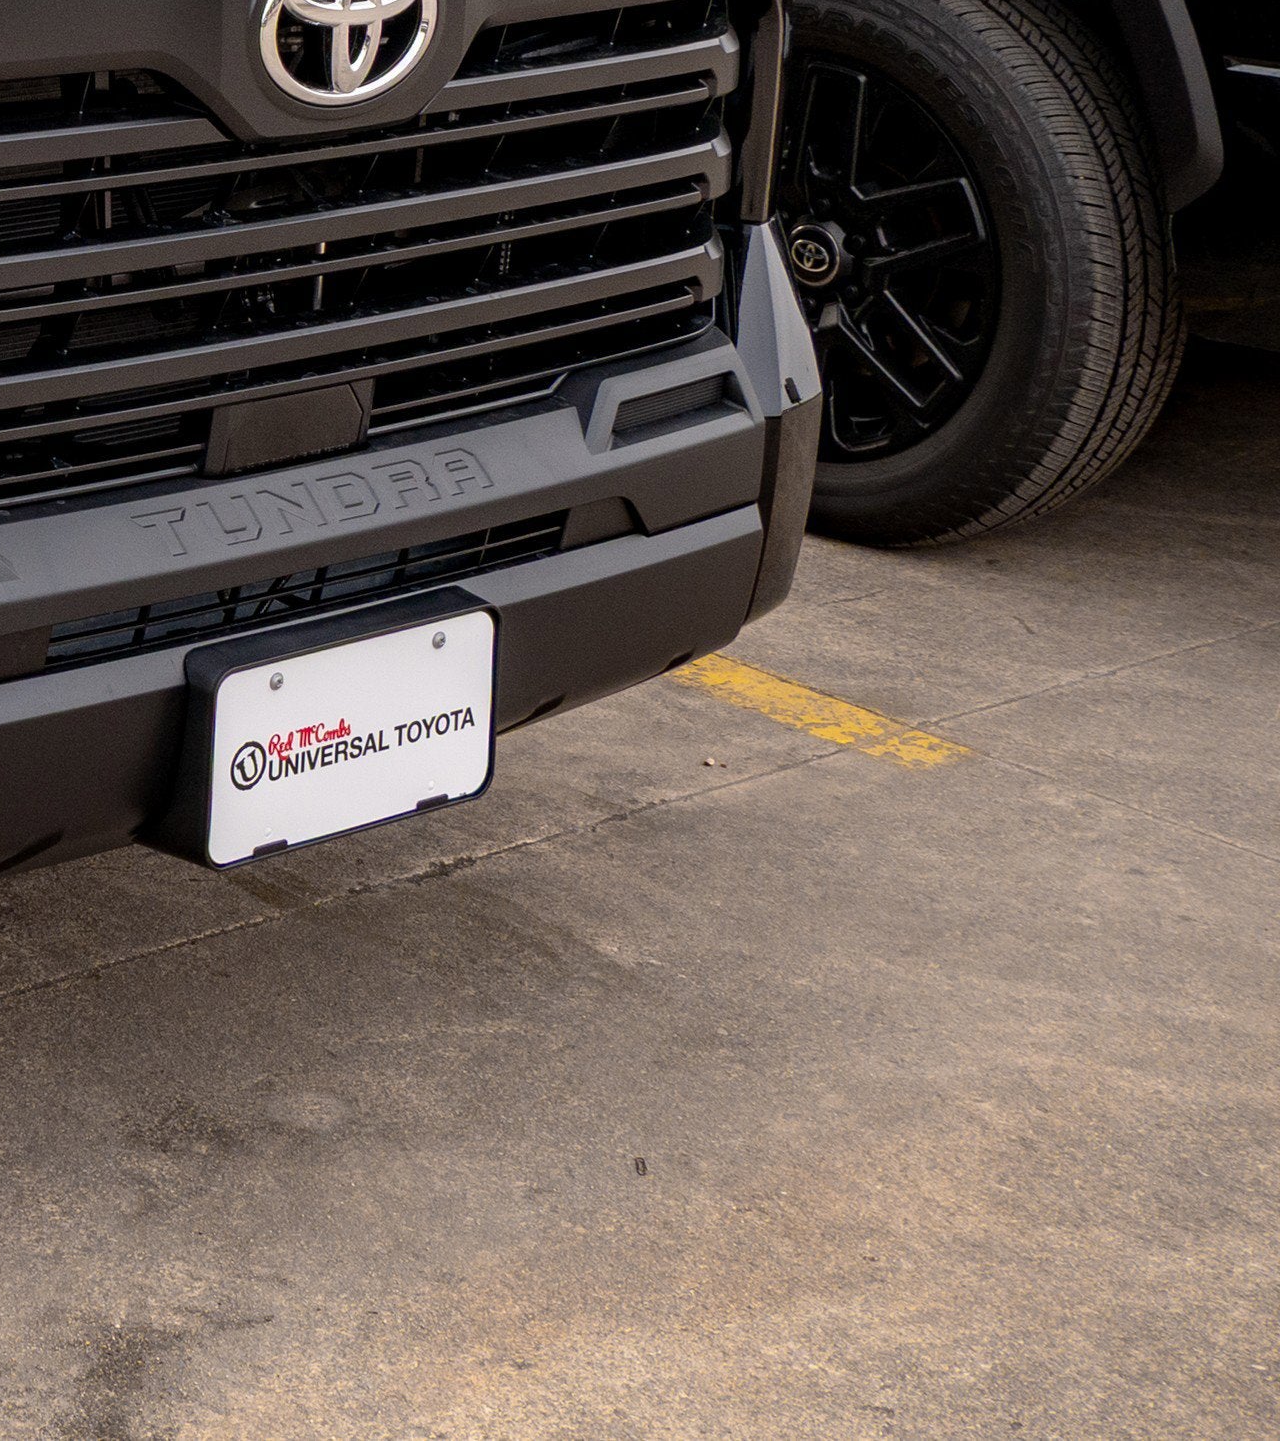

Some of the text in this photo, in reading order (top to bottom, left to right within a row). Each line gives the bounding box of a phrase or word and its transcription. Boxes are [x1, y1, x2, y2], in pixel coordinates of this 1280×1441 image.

[130, 448, 494, 557] TUNDRA
[268, 718, 351, 761] Red McCombs
[268, 707, 476, 781] UNIVERSAL TOYOTA
